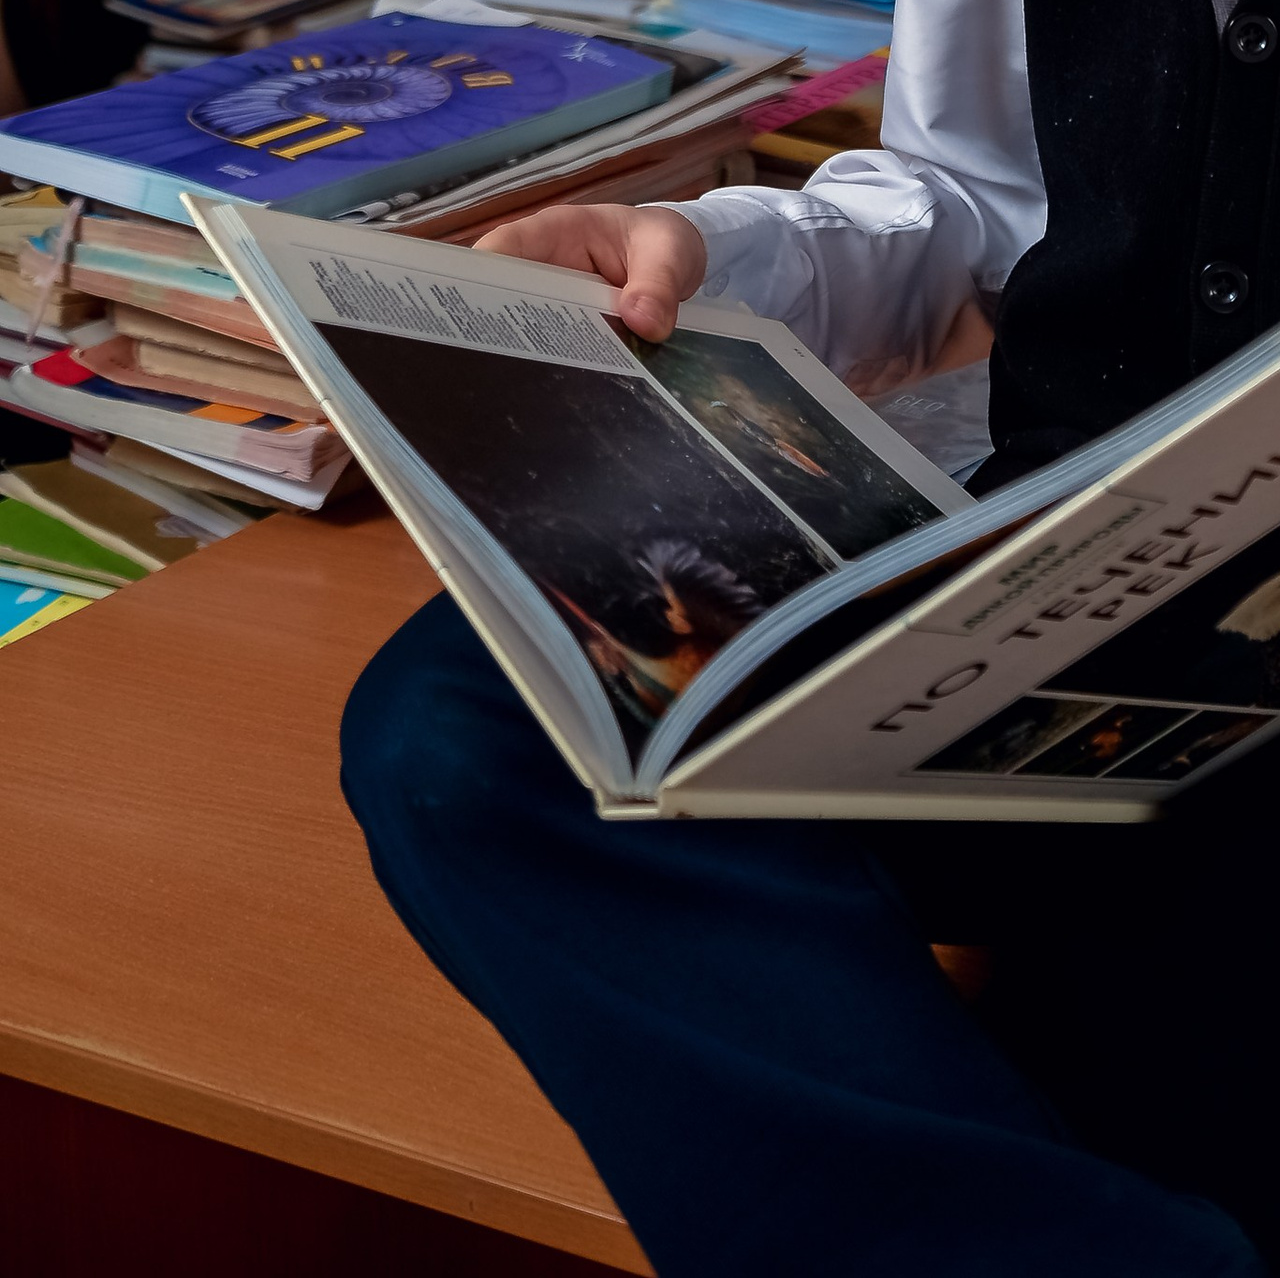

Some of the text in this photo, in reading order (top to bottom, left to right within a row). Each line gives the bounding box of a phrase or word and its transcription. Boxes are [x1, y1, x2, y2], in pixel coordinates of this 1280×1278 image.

[233, 113, 366, 161] 11
[998, 544, 1060, 586] МИР
[1088, 542, 1223, 622] РЕК
[870, 661, 988, 733] ПО
